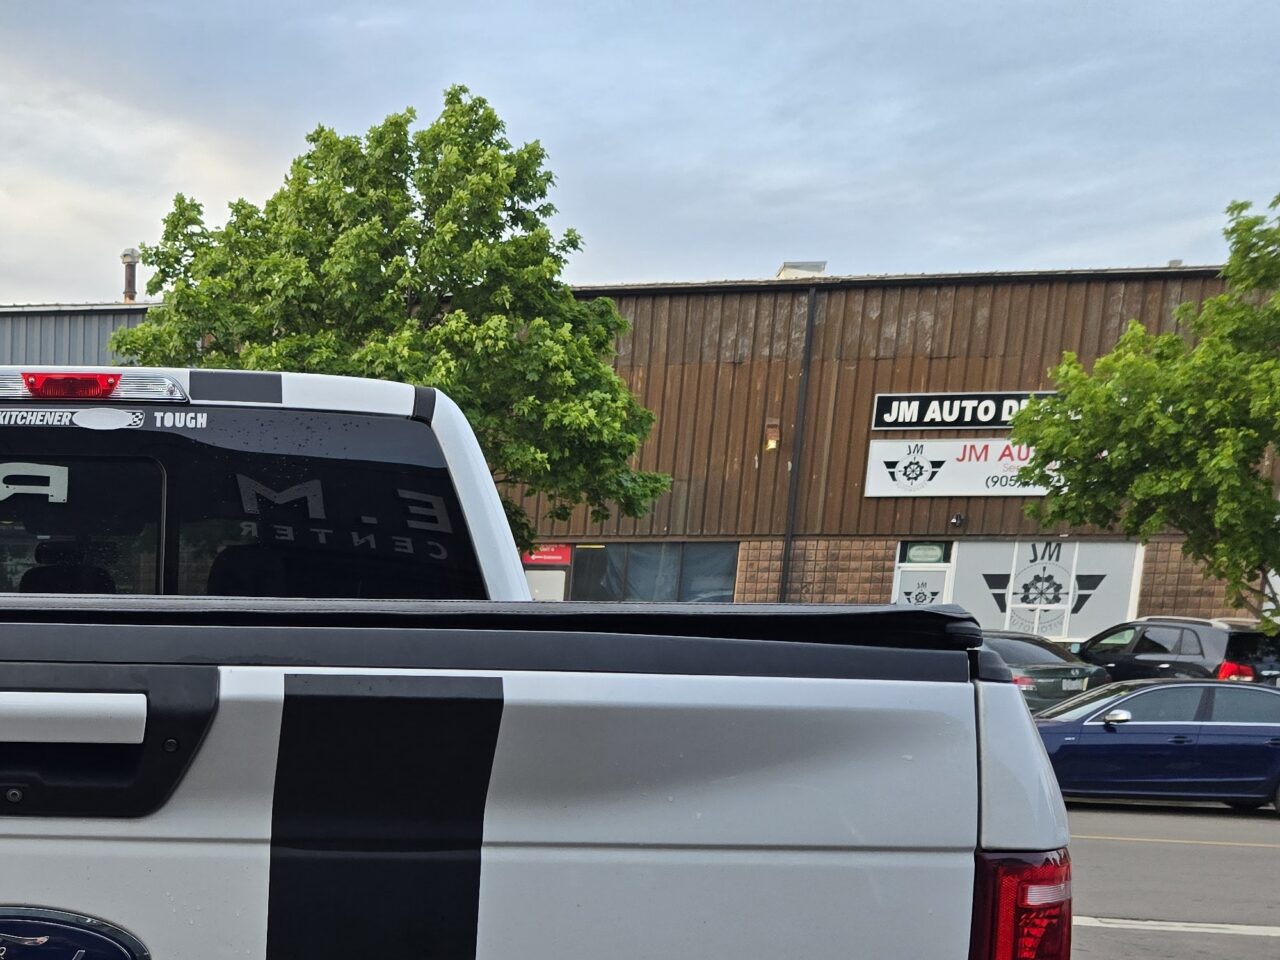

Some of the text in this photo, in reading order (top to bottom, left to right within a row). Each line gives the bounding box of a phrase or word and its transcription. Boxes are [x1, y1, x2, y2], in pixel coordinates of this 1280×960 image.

[154, 411, 208, 428] TOUGH
[883, 401, 920, 423] JM
[923, 400, 996, 422] AUTO
[955, 444, 989, 462] JM
[1029, 541, 1062, 563] JM
